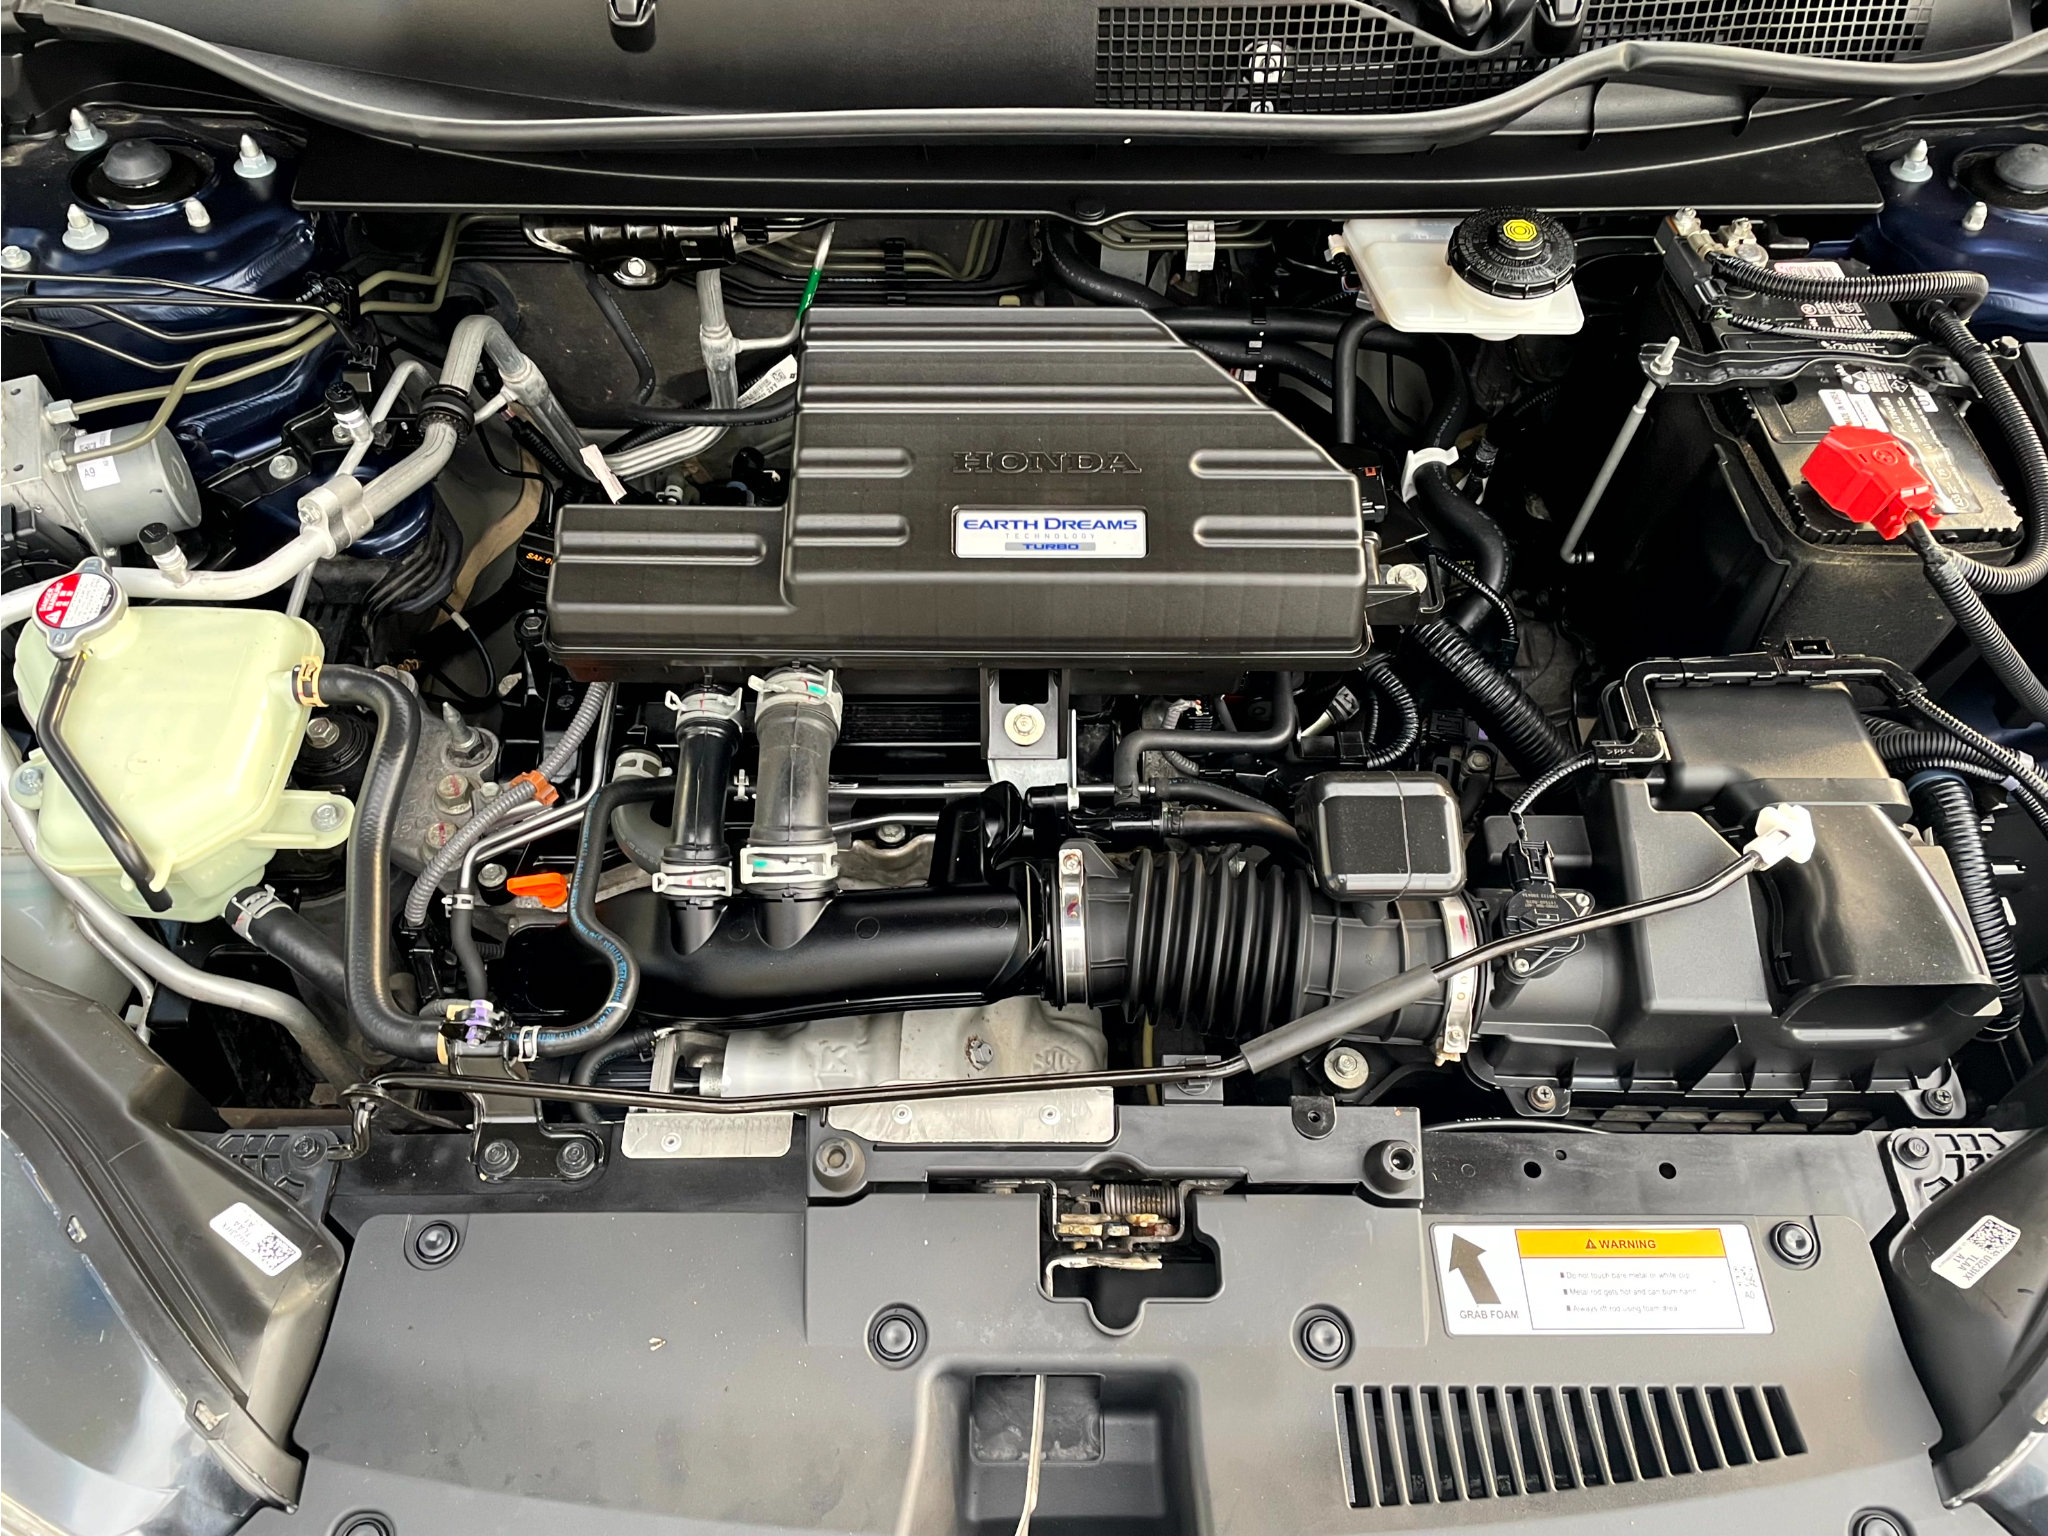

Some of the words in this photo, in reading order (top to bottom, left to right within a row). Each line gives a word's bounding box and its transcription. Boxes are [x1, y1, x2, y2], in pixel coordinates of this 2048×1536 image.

[952, 452, 1142, 474] HONDA
[963, 520, 1038, 530] EARTH
[526, 552, 544, 562] SAE
[1600, 1240, 1657, 1249] WARNING
[1460, 1310, 1488, 1320] GRAB
[1490, 1310, 1519, 1320] FOAM
